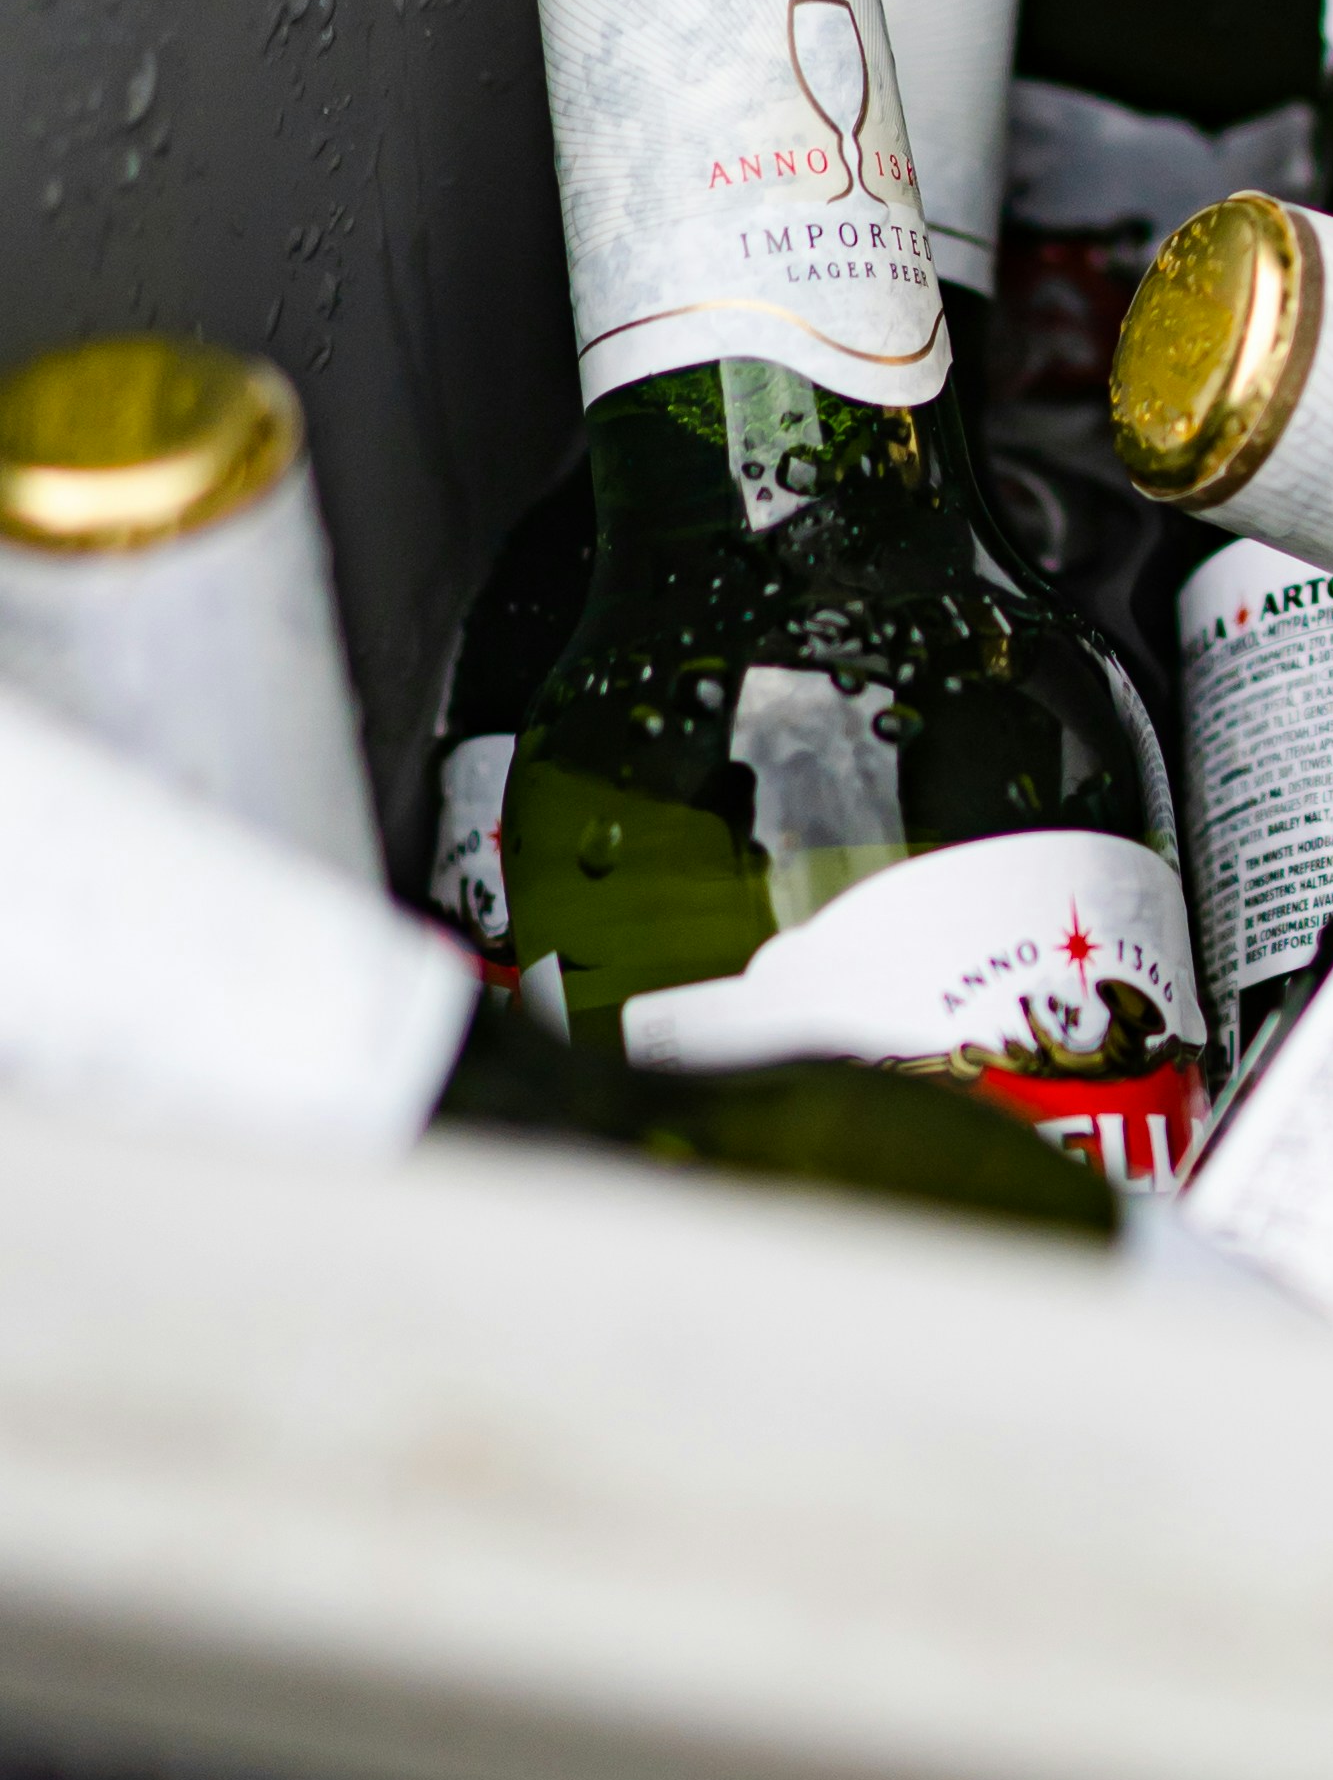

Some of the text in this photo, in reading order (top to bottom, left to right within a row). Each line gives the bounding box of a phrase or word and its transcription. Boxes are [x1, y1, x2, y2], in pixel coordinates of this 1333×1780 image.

[709, 148, 828, 189] ANNO
[740, 222, 932, 262] IMPORTED
[787, 261, 929, 288] LAGER BEER
[1256, 897, 1310, 927] PREFERENCE
[1260, 915, 1320, 944] CONSUMARSI
[1246, 931, 1314, 966] BEST BEFORE
[942, 939, 1038, 1015] ANNO
[1117, 937, 1173, 1004] 1366
